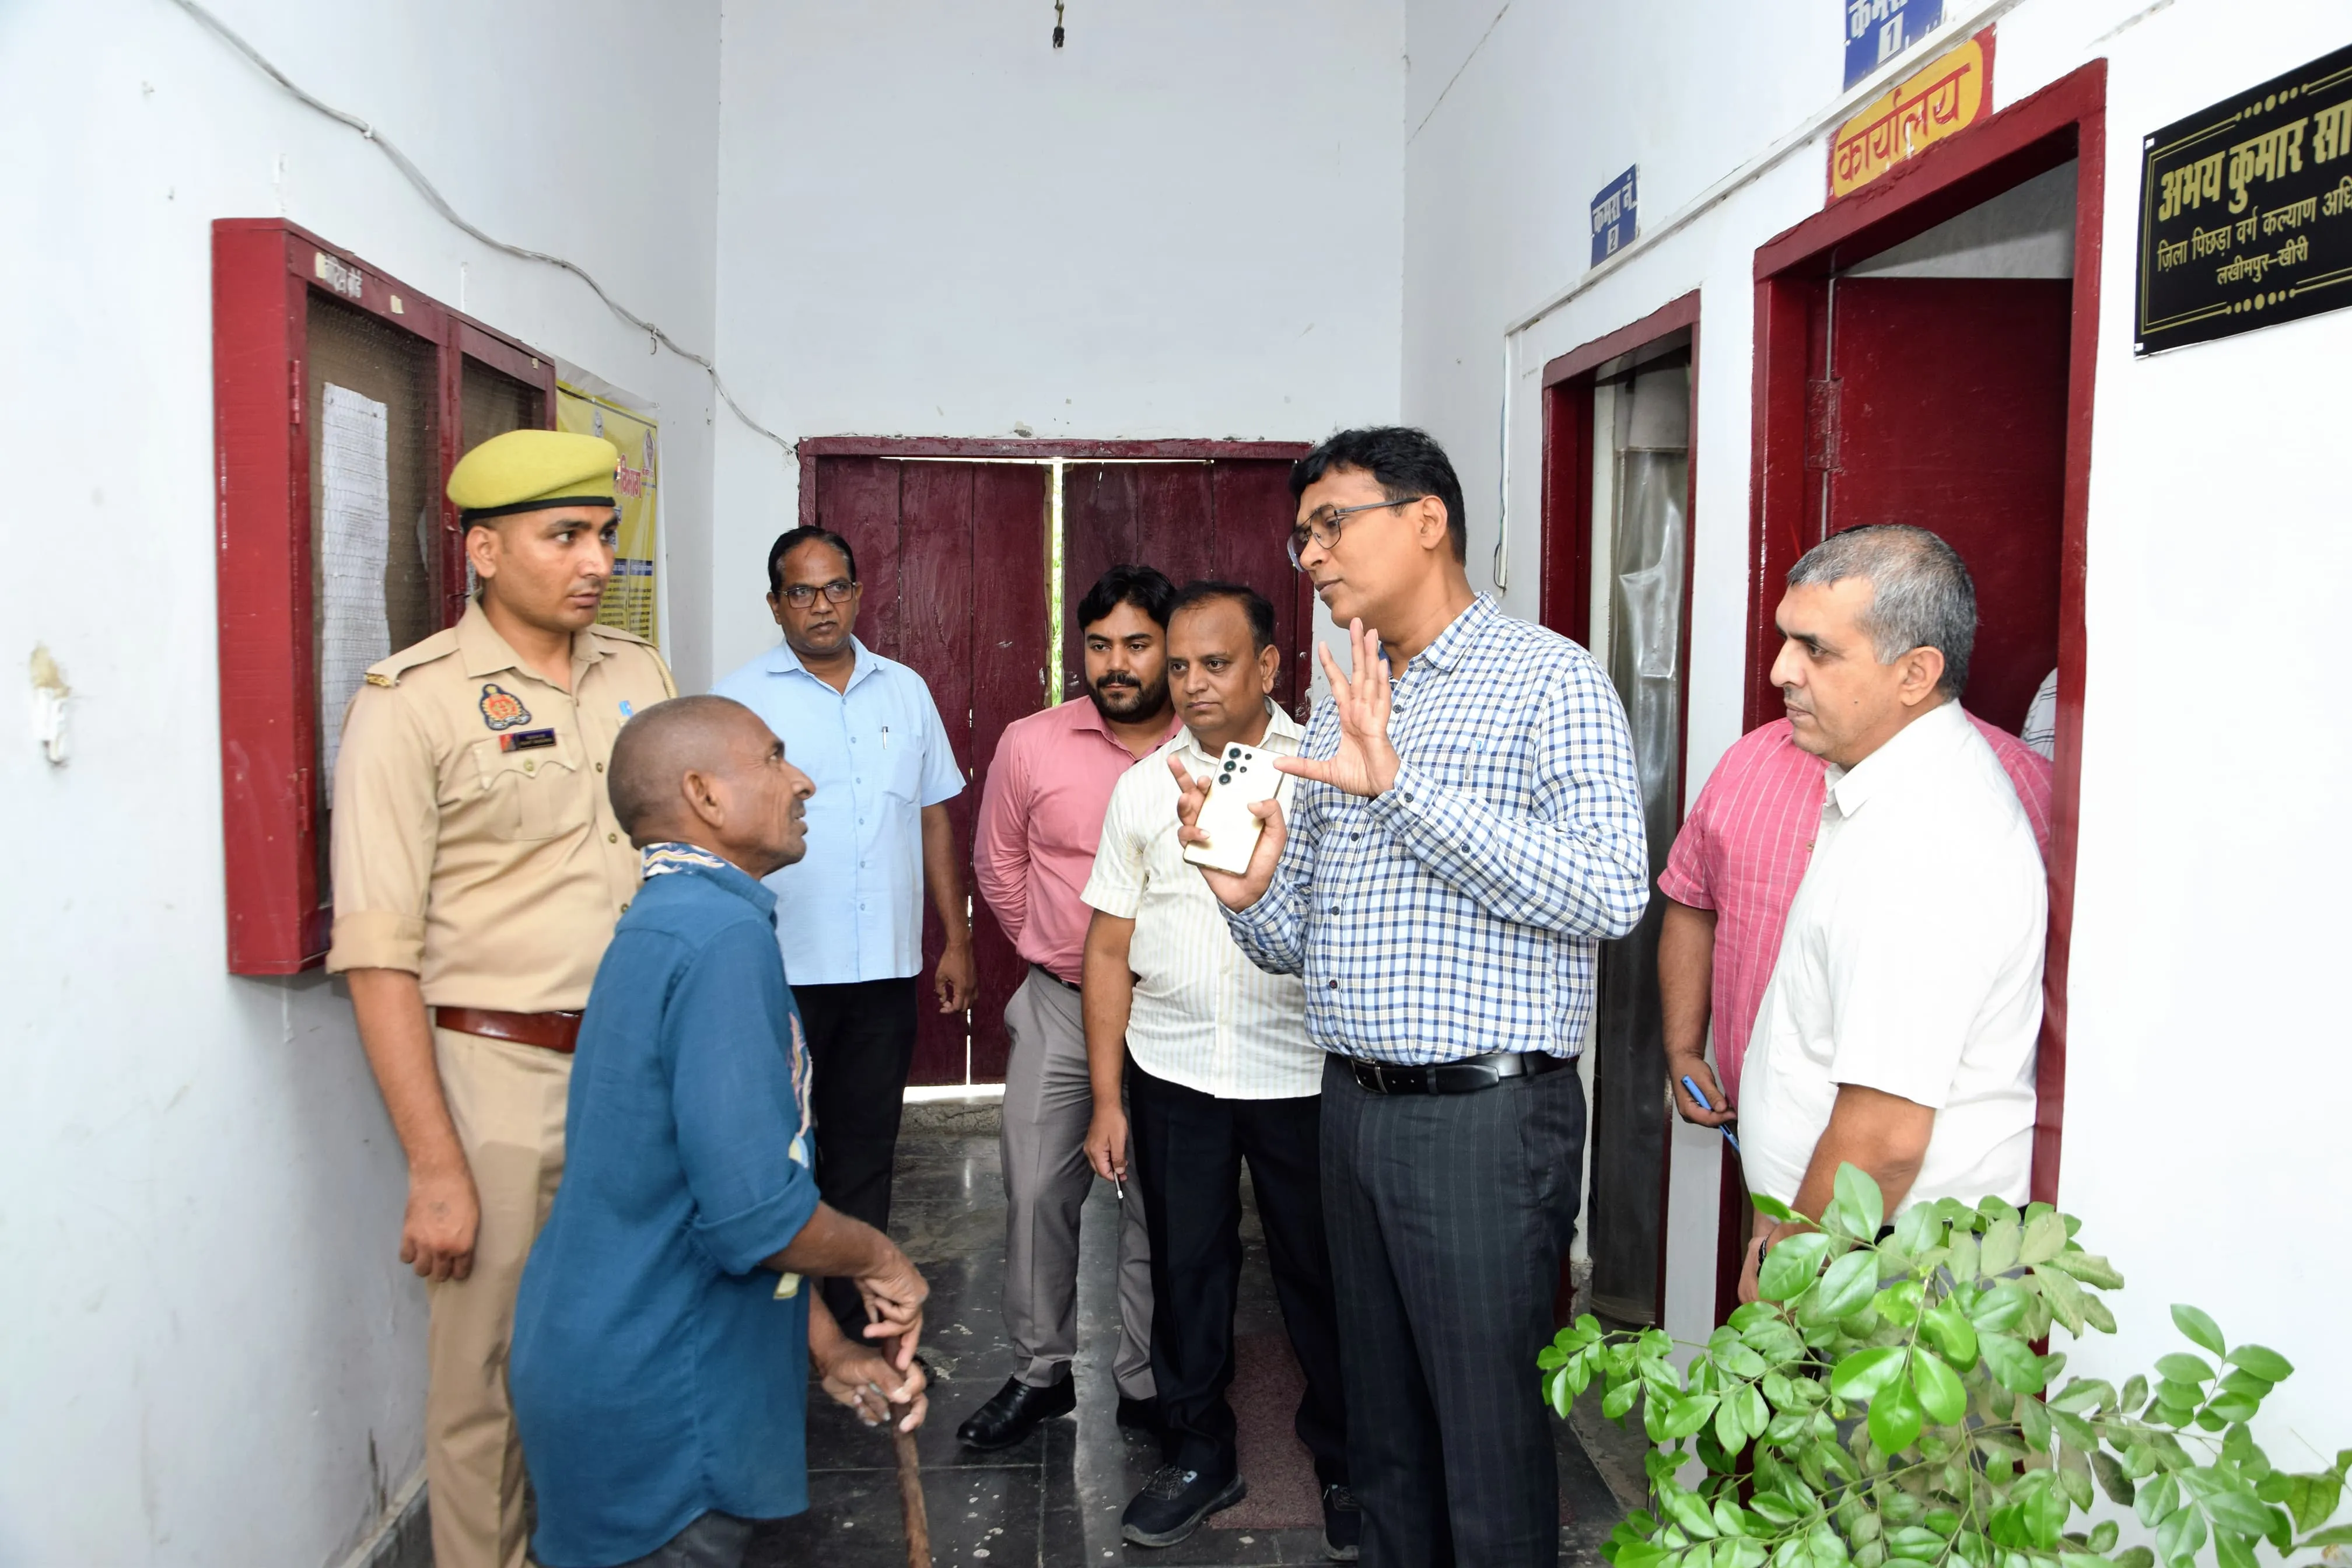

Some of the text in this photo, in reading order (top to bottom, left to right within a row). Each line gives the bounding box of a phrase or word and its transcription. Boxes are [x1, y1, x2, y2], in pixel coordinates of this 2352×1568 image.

[1838, 62, 1971, 182] कार्यालय
[1592, 190, 1620, 233] कमरा
[2159, 151, 2225, 222] अभय
[2228, 117, 2308, 214] कुमार
[2191, 226, 2232, 260] पिछड़ा
[2235, 206, 2258, 244] वर्ग
[2262, 197, 2317, 236] कल्याण
